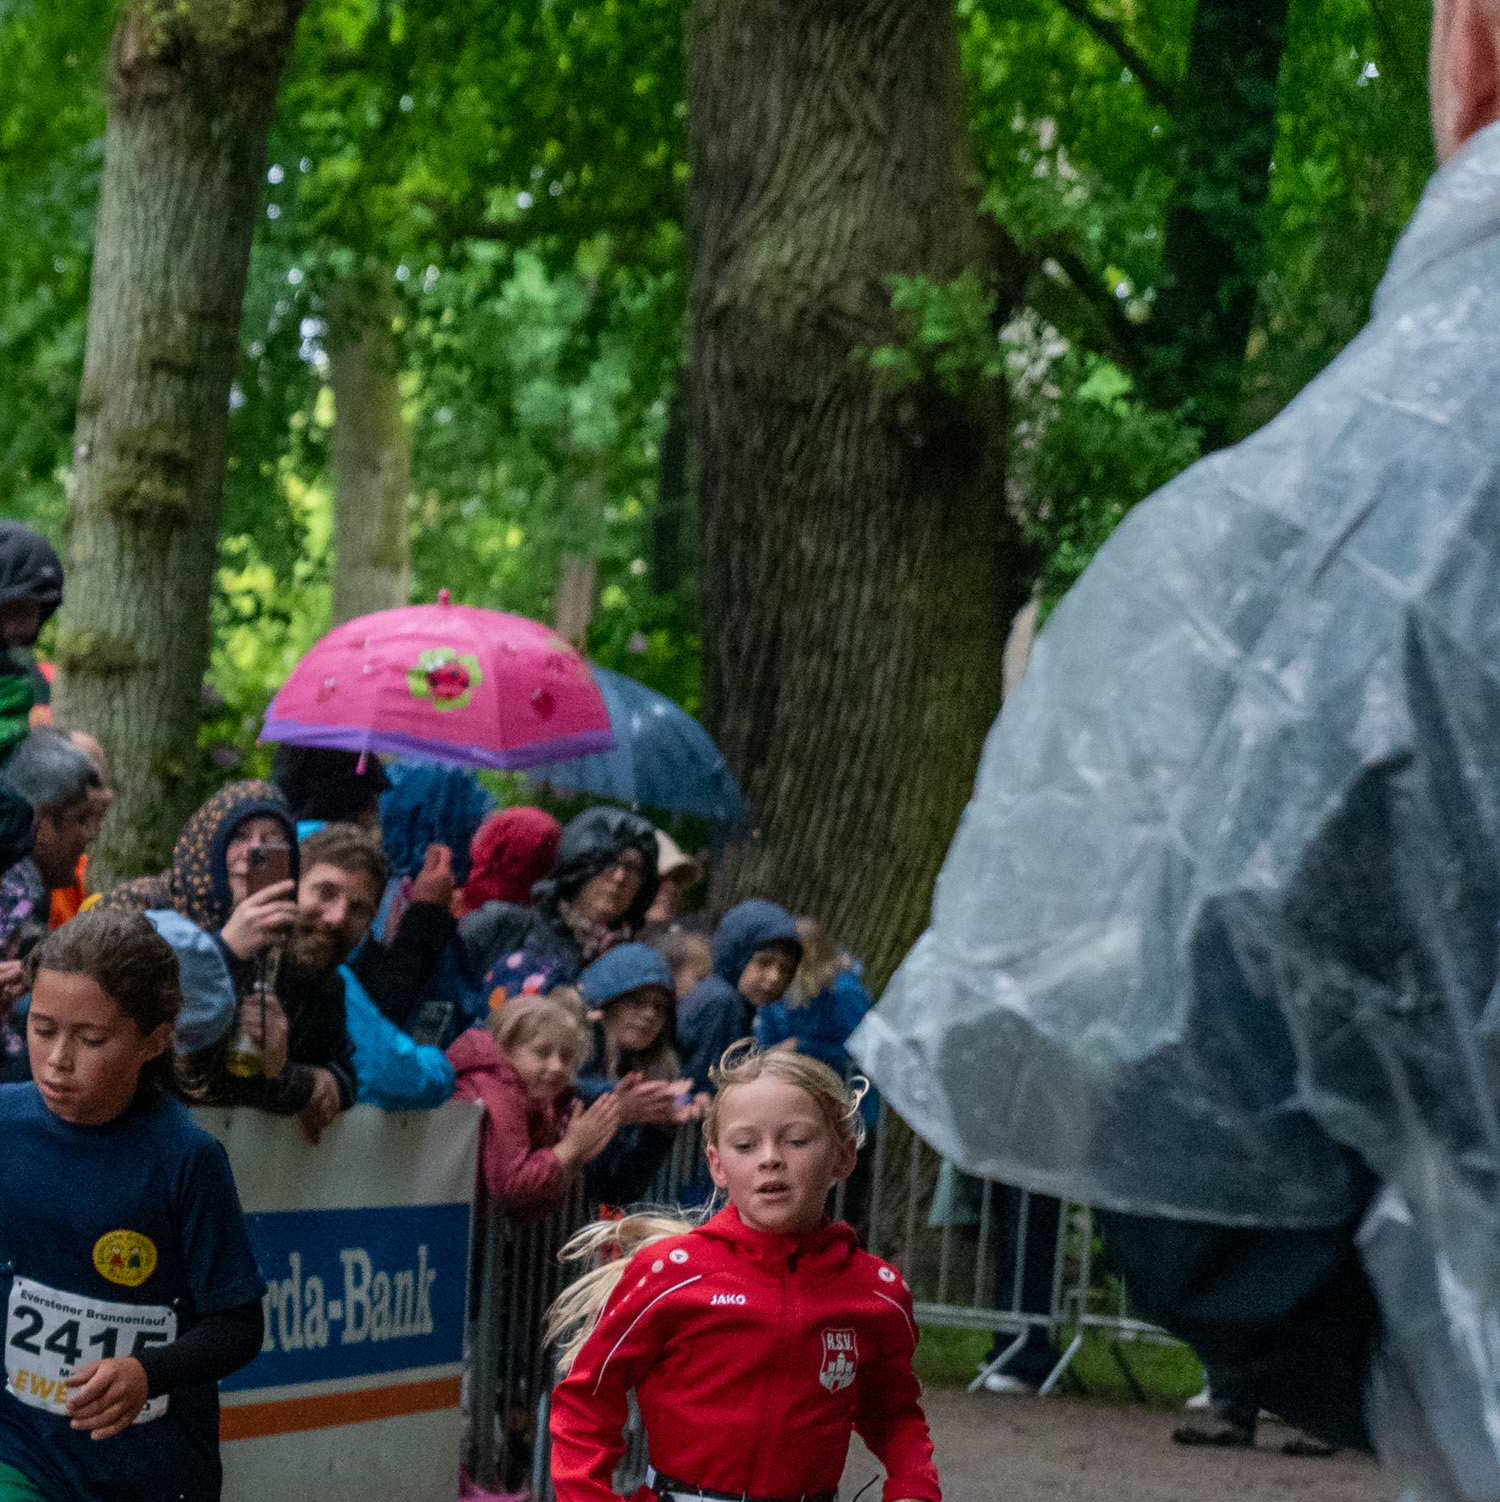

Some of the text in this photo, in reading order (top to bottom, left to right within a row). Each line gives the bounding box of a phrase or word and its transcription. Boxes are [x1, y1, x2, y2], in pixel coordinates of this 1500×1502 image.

[20, 1289, 166, 1327] Everstener Brunnenlauf
[710, 1293, 746, 1305] JAKO
[826, 1332, 854, 1351] R.S.V.
[14, 1368, 68, 1404] EWE
